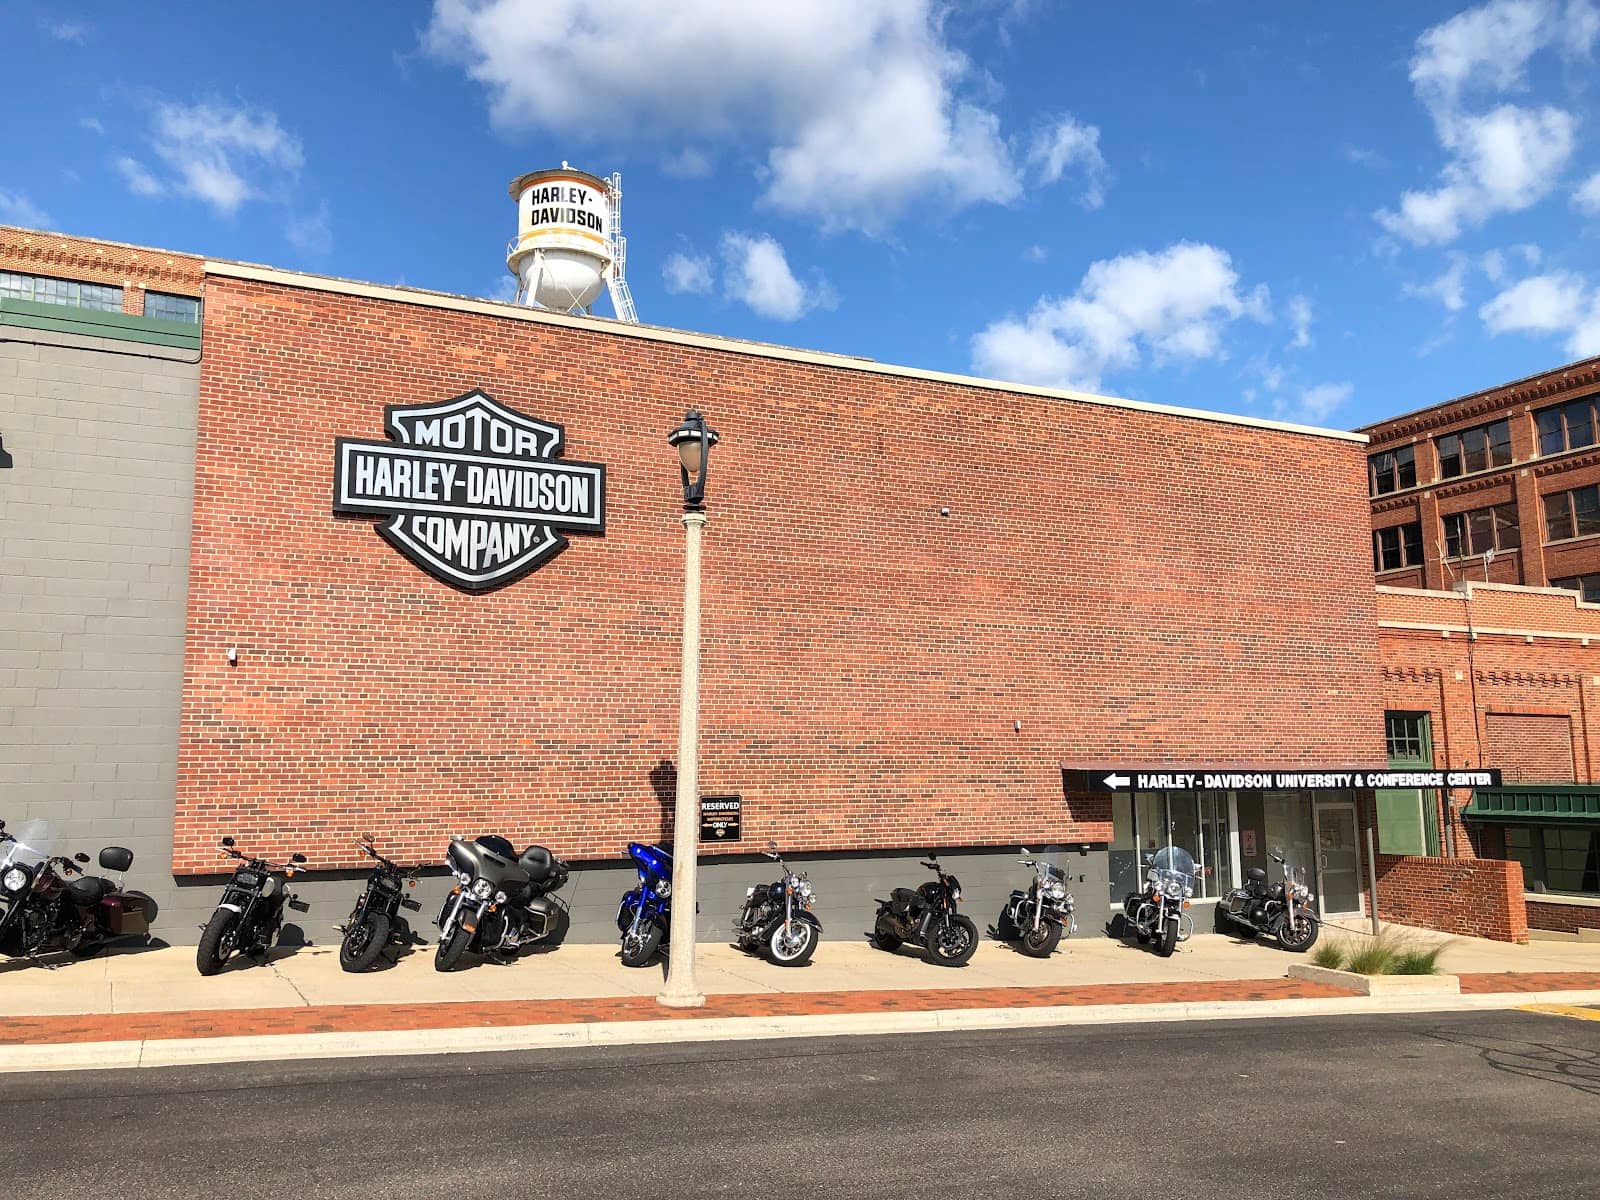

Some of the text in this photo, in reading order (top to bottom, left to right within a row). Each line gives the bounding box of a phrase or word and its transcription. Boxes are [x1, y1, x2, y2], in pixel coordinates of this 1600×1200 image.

[531, 207, 603, 233] DAVIDSON
[415, 407, 537, 457] MOTOR
[355, 455, 588, 513] HARLEY-DAVIDSON
[412, 515, 536, 570] COMPANY
[1276, 773, 1352, 788] UNIVERSITY
[1354, 774, 1363, 787] &
[1366, 773, 1443, 787] CONFERENCE
[1447, 773, 1492, 786] CENTER
[701, 802, 739, 810] RESERVED
